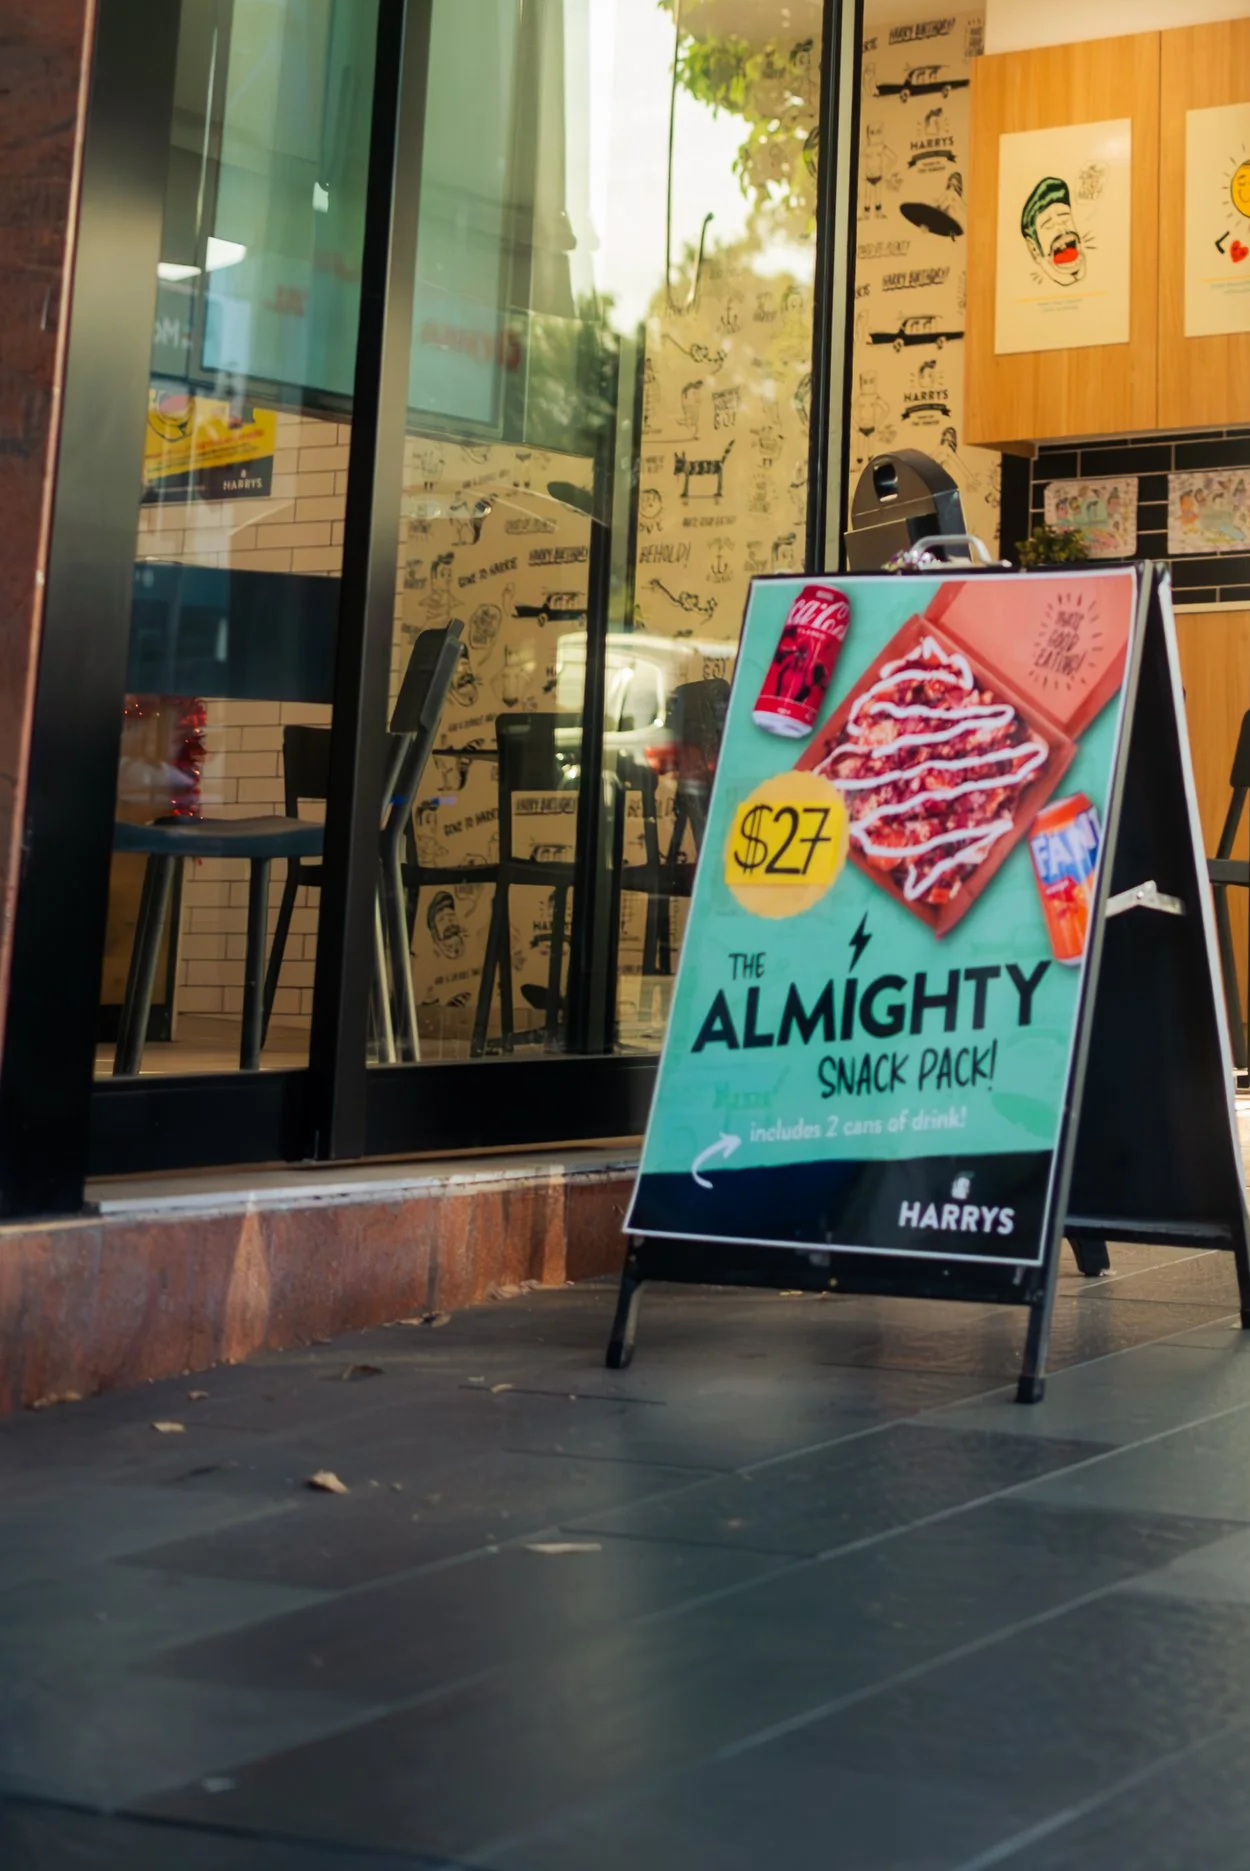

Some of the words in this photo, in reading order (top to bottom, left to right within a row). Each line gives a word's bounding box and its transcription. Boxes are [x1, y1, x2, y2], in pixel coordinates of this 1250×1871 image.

[734, 804, 831, 875] $27
[728, 952, 766, 981] THE
[691, 960, 1052, 1054] ALMIGHTY
[818, 1052, 910, 1100] SNACK
[918, 1038, 999, 1092] PACK!
[750, 1115, 821, 1143] includes
[825, 1115, 841, 1139] 2
[843, 1118, 883, 1137] cans
[886, 1108, 911, 1134] of
[911, 1105, 968, 1130] drink!
[898, 1200, 1016, 1235] HARRYS
